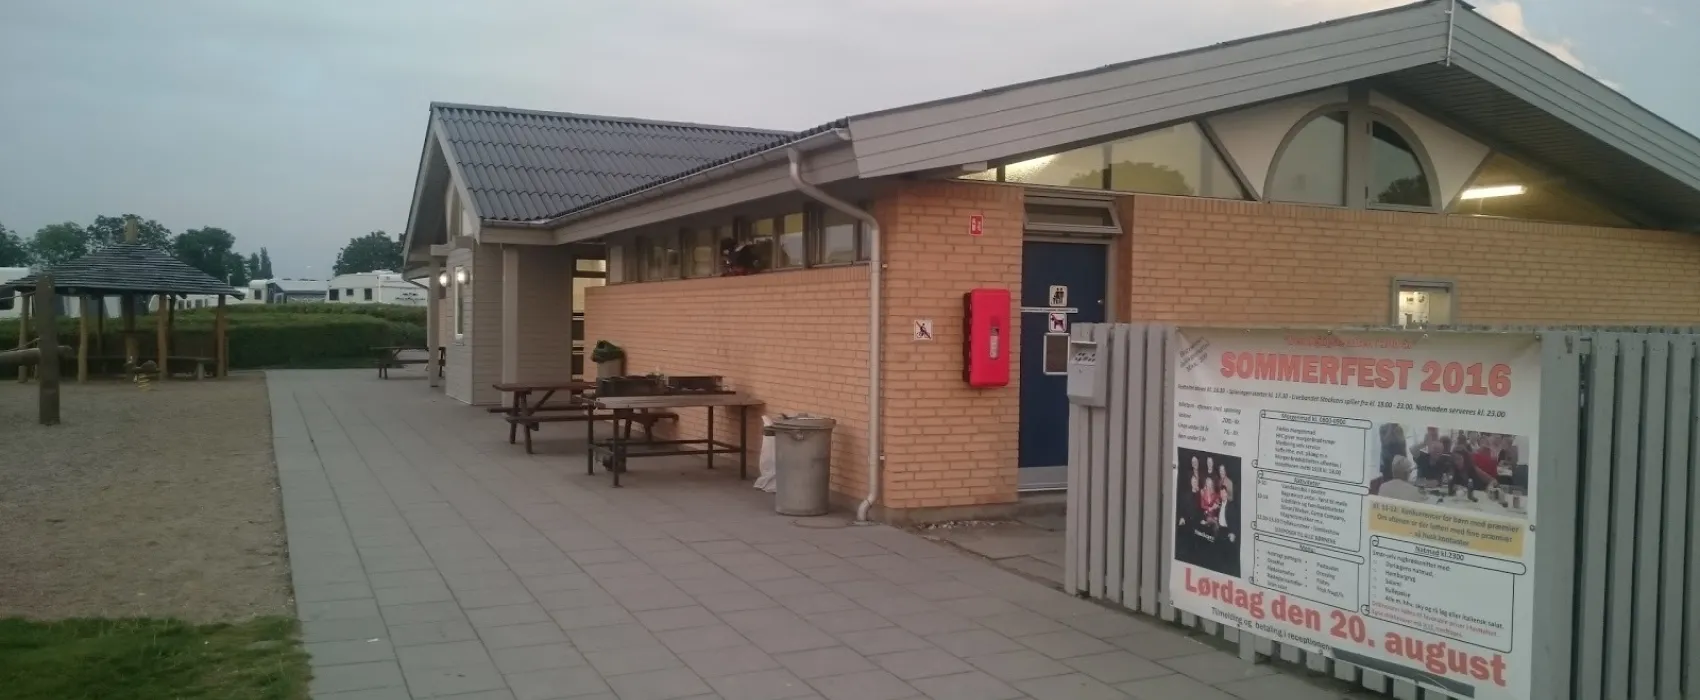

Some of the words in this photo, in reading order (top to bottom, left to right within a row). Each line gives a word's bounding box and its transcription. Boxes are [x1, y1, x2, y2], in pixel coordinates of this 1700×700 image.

[1219, 351, 1413, 390] SOMMERFEST
[1420, 360, 1512, 396] 2016
[1414, 546, 1439, 556] Natmad
[1184, 567, 1265, 620] Lørdag
[1271, 595, 1320, 632] den
[1329, 609, 1376, 648] 20.
[1384, 630, 1507, 687] august
